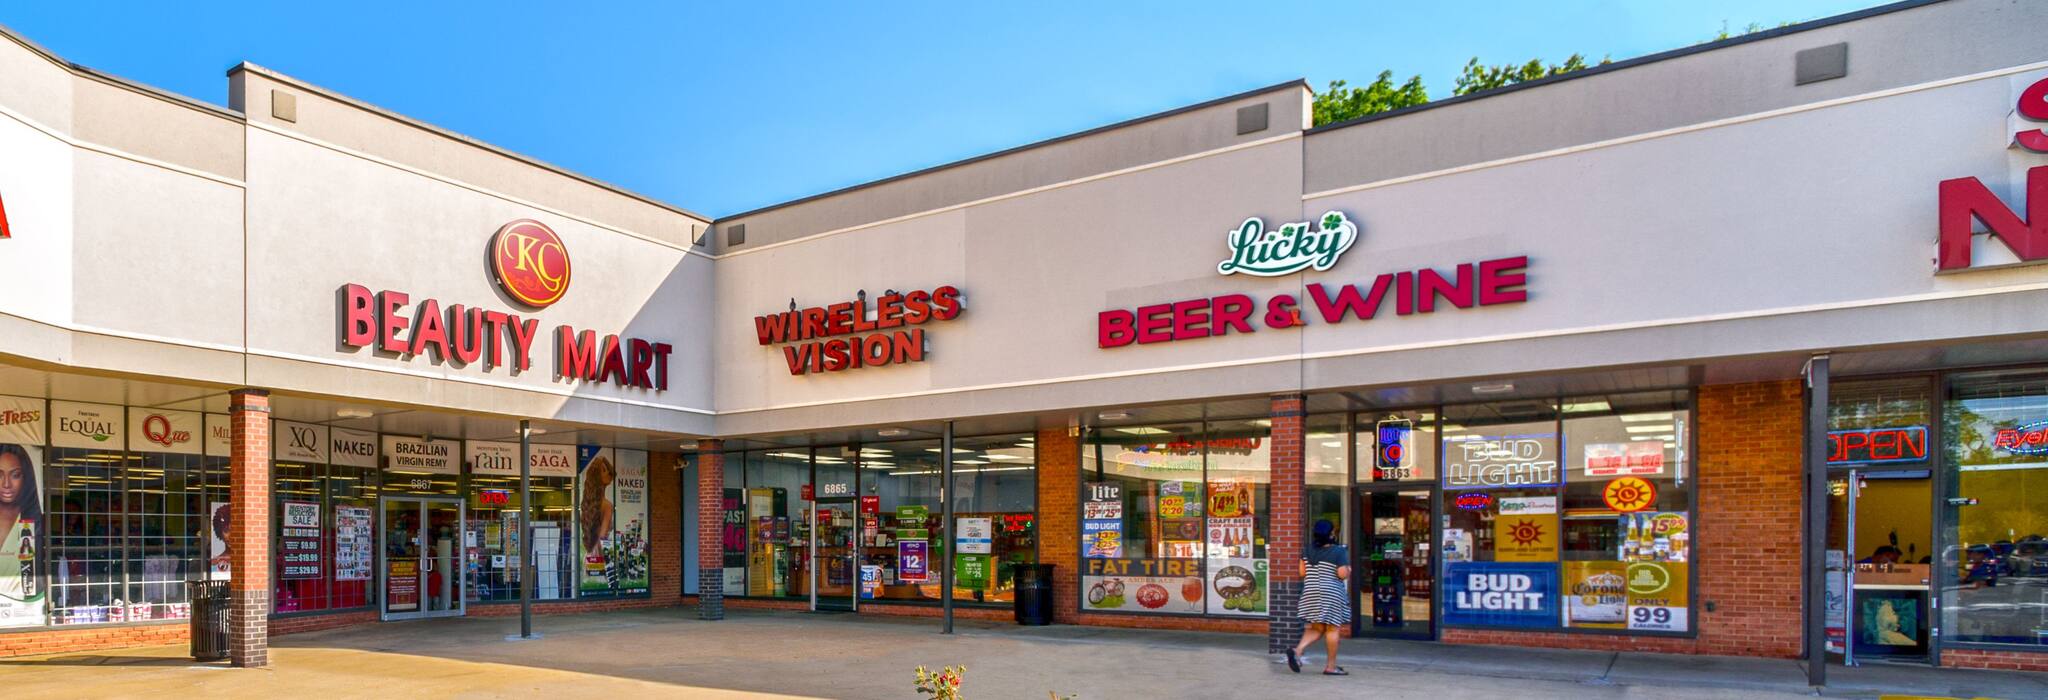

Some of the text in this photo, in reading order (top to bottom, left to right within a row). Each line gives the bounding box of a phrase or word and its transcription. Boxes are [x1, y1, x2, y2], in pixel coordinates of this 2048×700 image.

[1220, 217, 1353, 273] Lucky
[503, 232, 563, 293] KC
[1097, 255, 1529, 349] BEER & WINE
[754, 285, 962, 346] WIRELESS
[340, 282, 673, 392] BEAUTY MART
[783, 328, 925, 376] VISION
[60, 416, 116, 438] EQUAL
[289, 426, 318, 452] XQ
[334, 439, 375, 457] NAKED
[395, 442, 449, 457] BRAZILIAN
[1464, 440, 1543, 462] BUD
[395, 455, 448, 468] VIRGIN REMY
[474, 451, 513, 470] rain
[530, 454, 570, 468] SAGA
[1449, 461, 1557, 486] LIGHT
[410, 478, 432, 490] 6867
[617, 478, 645, 489] NAKED
[824, 483, 847, 494] 6865
[1090, 485, 1120, 502] Lite
[292, 516, 312, 525] SALE
[1085, 522, 1121, 530] BUD LIGHT
[1088, 559, 1199, 577] FAT TIRE
[1468, 573, 1532, 592] BUD
[1572, 582, 1625, 596] Corona
[1456, 591, 1544, 611] LIGHT
[1634, 598, 1670, 606] ONLY
[1633, 606, 1672, 623] 99
